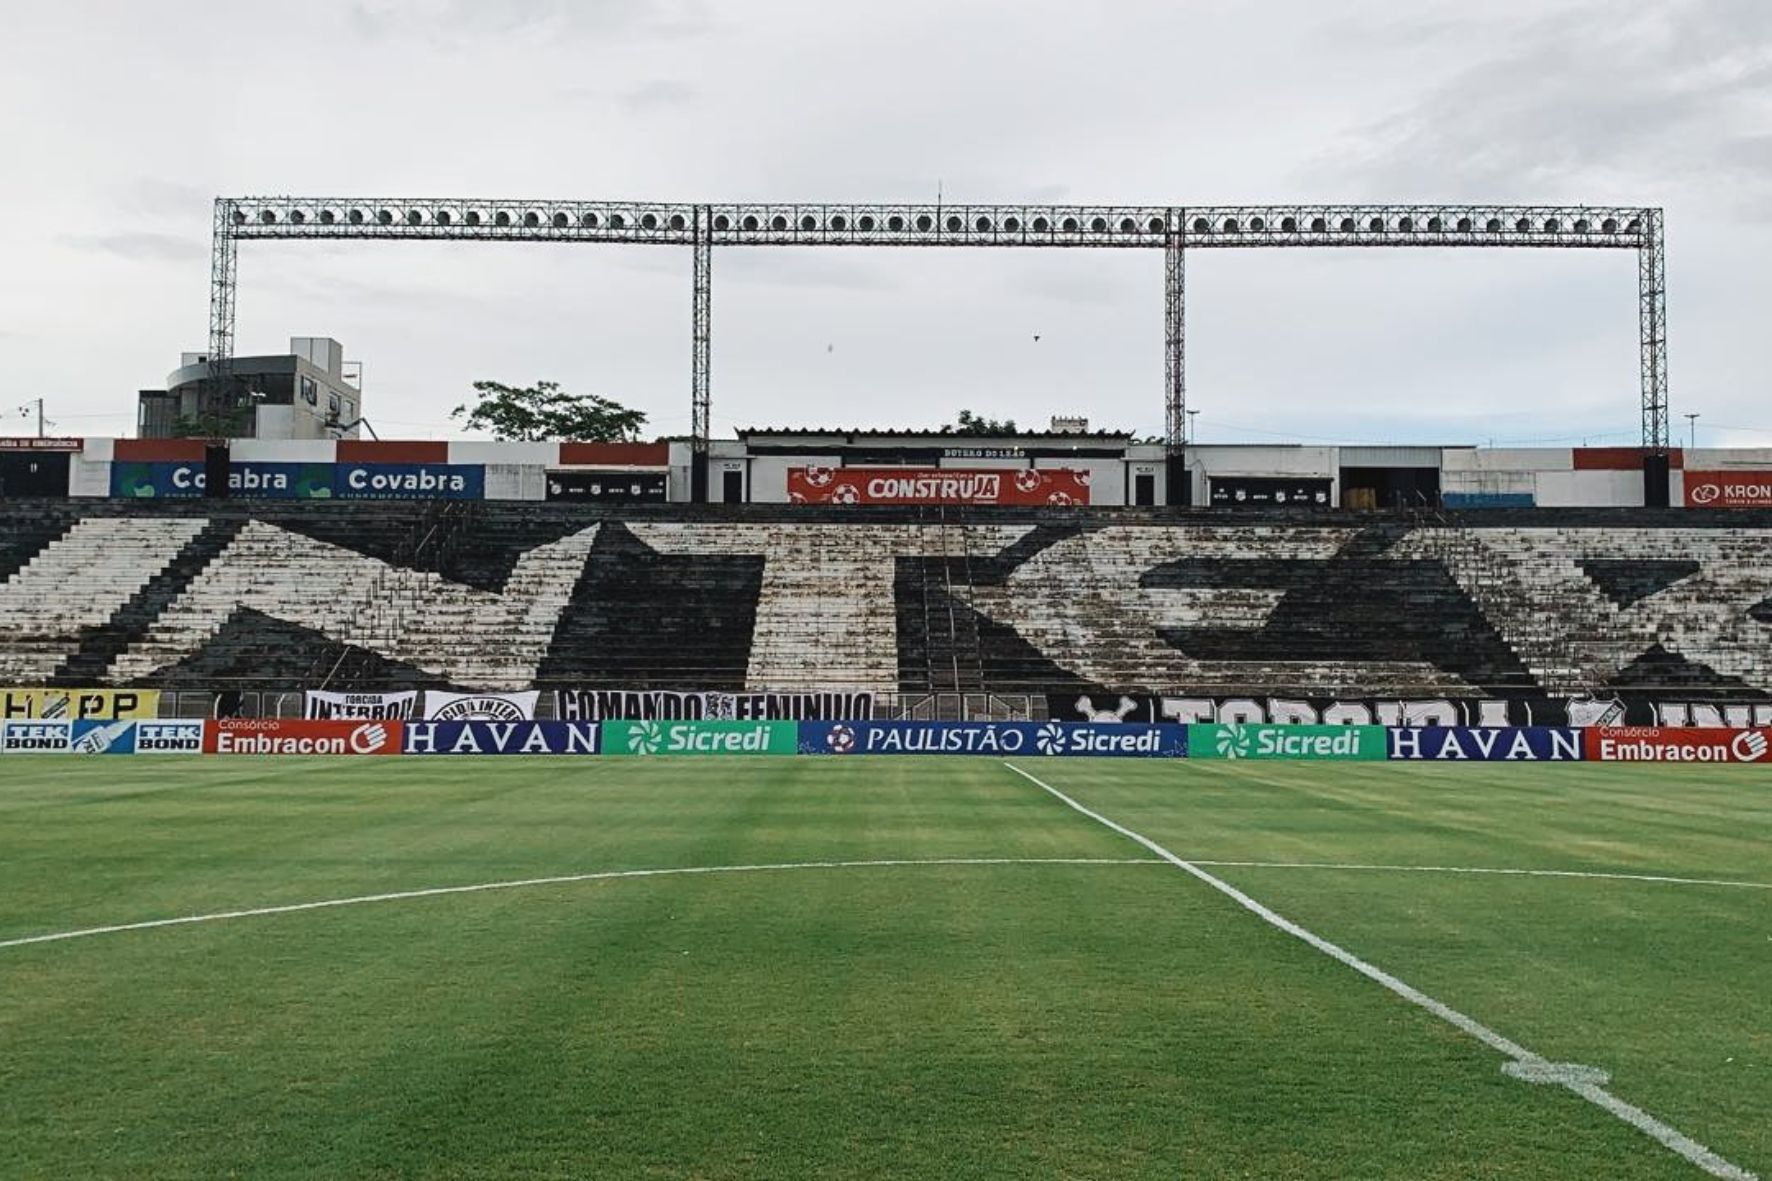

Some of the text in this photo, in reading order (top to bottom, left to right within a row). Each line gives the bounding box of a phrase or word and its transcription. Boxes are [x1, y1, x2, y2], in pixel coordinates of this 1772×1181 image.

[172, 467, 287, 489] Coabra
[348, 468, 465, 491] Covabra
[9, 726, 66, 738] TEK
[141, 727, 197, 739] TEK
[217, 718, 280, 730] Consórcio
[1598, 726, 1660, 738] Consórcio
[6, 738, 68, 749] BOND
[138, 739, 200, 750] BOND
[217, 733, 345, 754] Embracon
[404, 722, 598, 753] HAVAN
[667, 725, 770, 751] Sicredi
[866, 724, 1161, 752] PAULISTÃO Sicredi
[1256, 729, 1360, 755] Sicredi
[1390, 728, 1582, 759] HAVAN
[1599, 739, 1728, 761] Embracon
